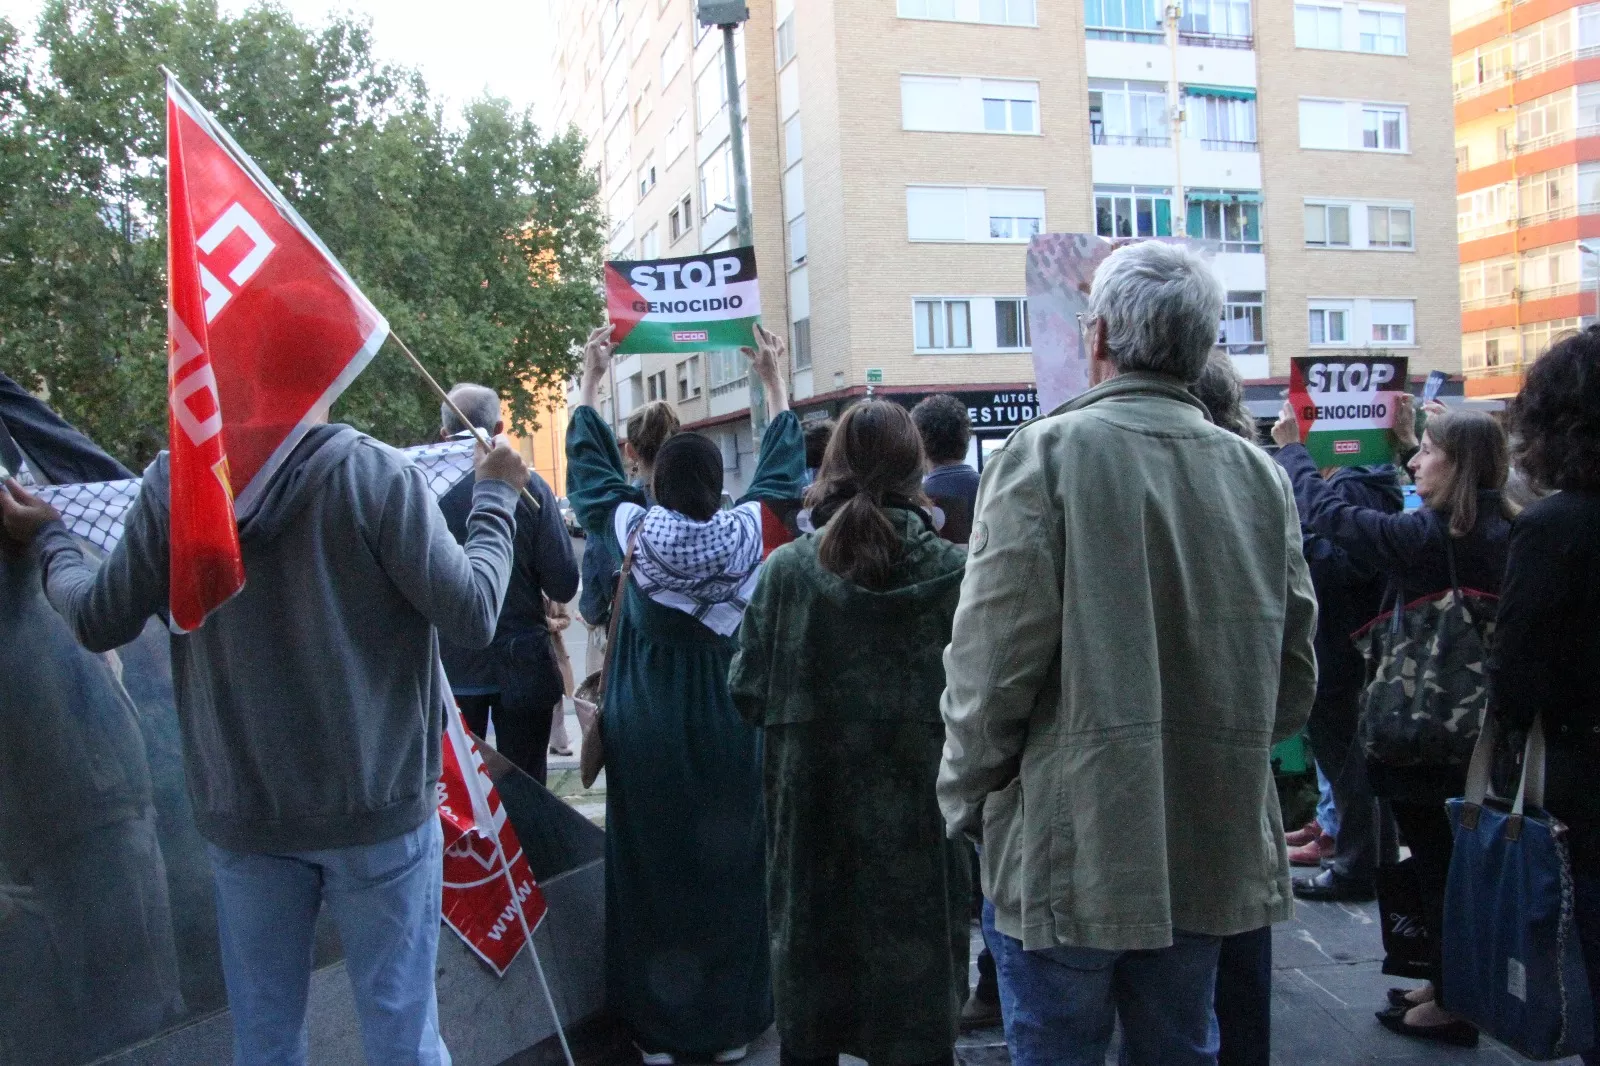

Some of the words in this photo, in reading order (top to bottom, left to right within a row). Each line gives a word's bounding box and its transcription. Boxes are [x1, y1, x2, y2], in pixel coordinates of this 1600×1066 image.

[630, 256, 741, 291] STOP
[632, 295, 743, 314] GENOCIDIO
[674, 332, 707, 341] CCOO
[1307, 362, 1395, 393] STOP
[1303, 404, 1387, 420] GENOCIDIO
